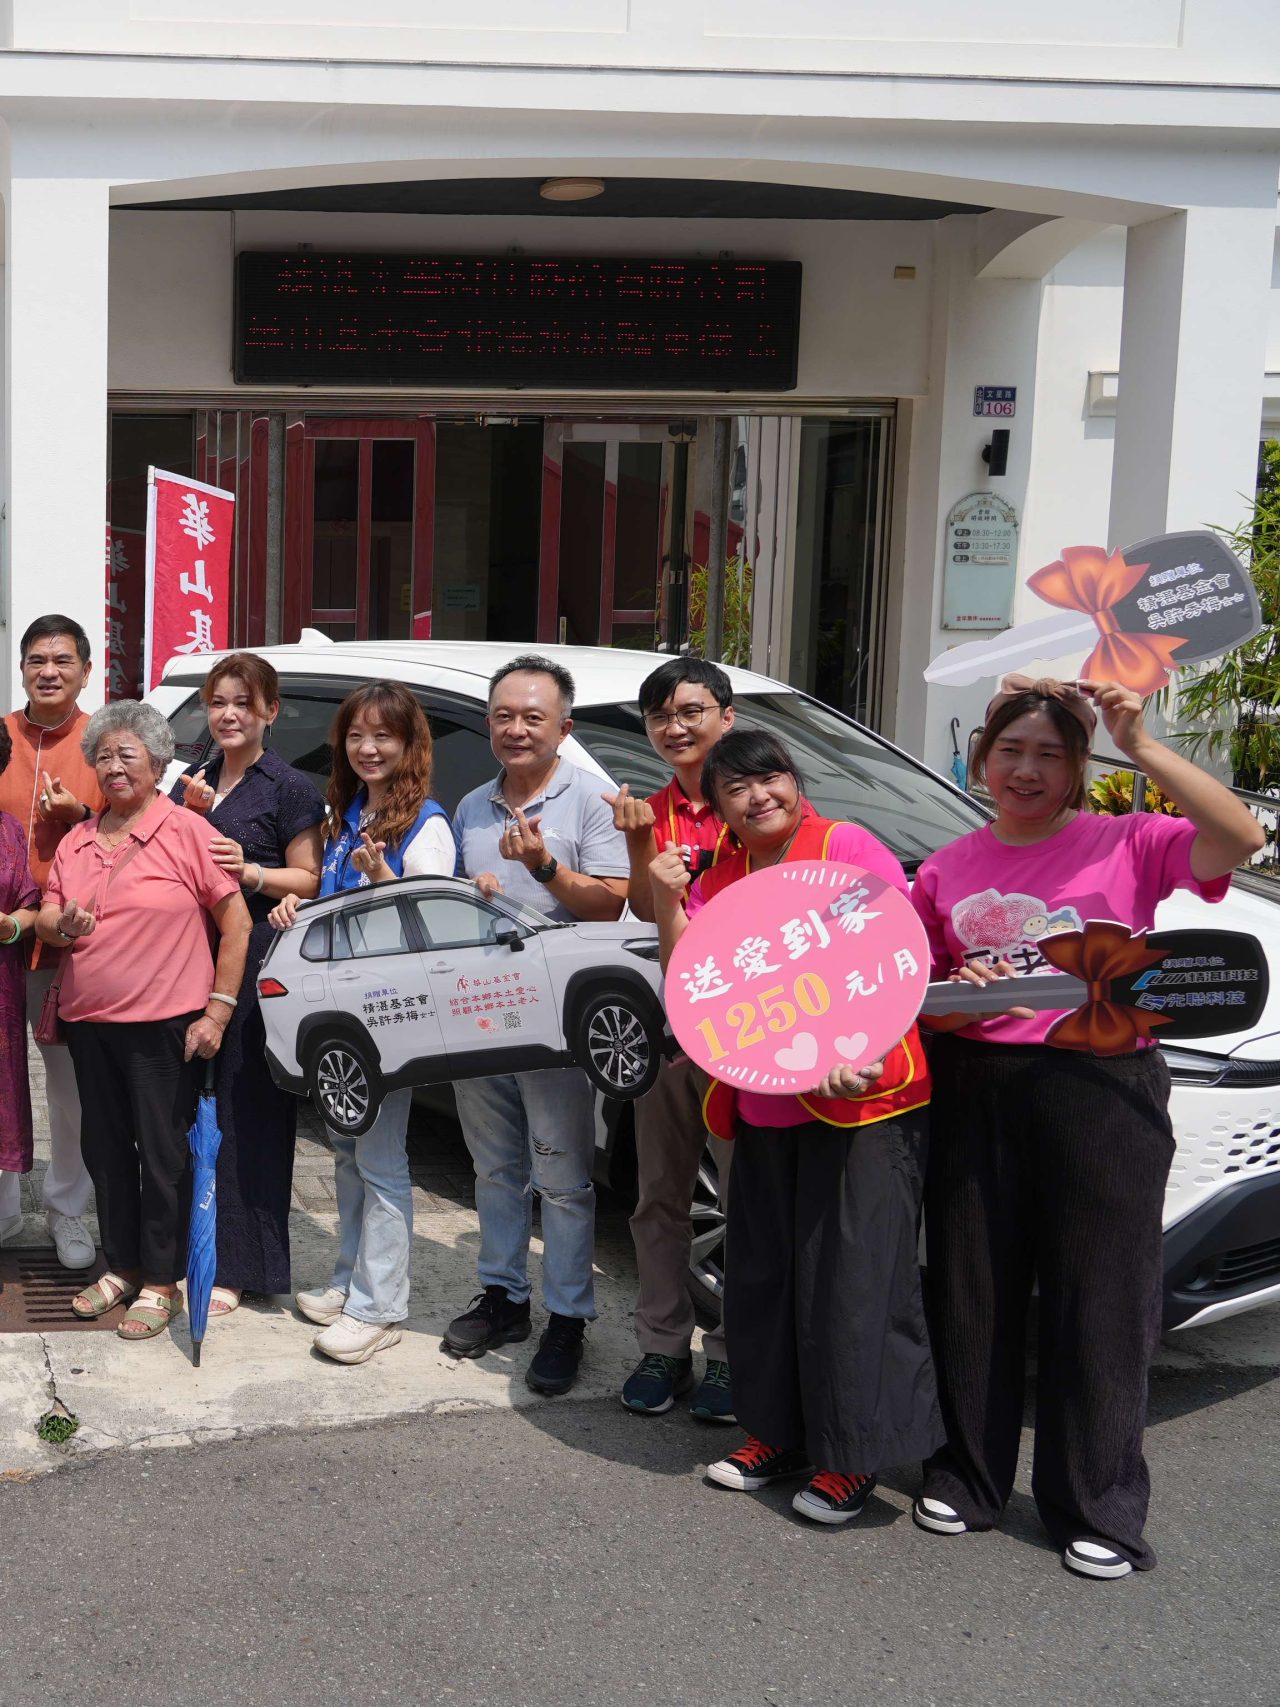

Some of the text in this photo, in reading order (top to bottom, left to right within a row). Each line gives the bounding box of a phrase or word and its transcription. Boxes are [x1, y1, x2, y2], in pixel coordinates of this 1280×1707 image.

[986, 402, 1012, 415] 106
[680, 887, 883, 1004] 送愛到家
[362, 993, 429, 1014] 精湛基金會
[695, 972, 832, 1063] 1250
